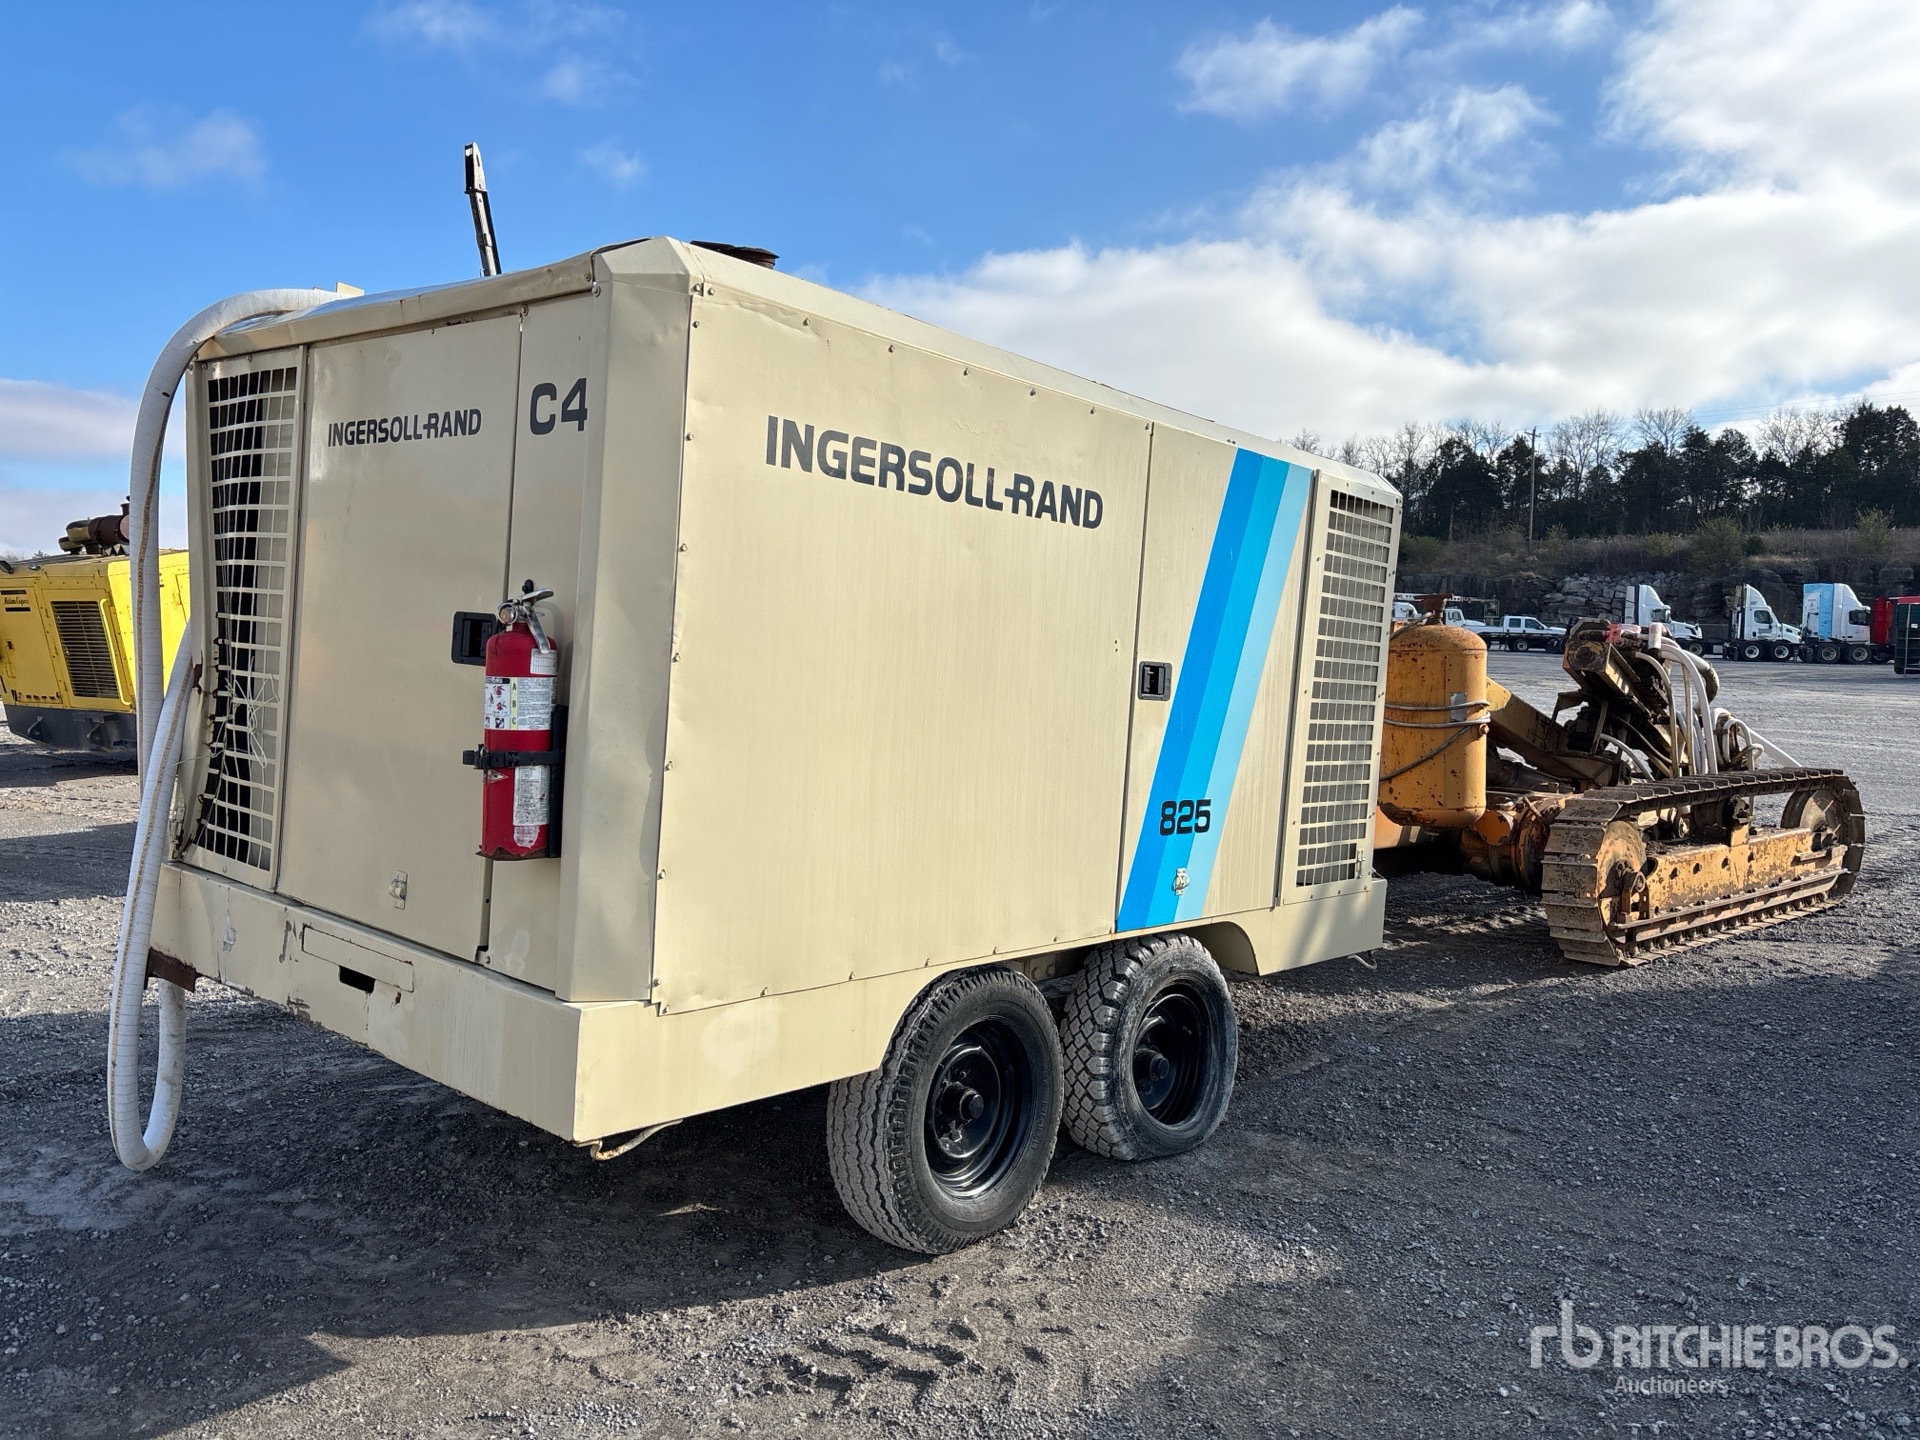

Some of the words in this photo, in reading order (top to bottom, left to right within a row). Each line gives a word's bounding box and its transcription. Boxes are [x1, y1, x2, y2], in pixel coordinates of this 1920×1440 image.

[327, 408, 482, 447] INGERSOLL-RAND
[529, 377, 588, 436] C4
[765, 414, 1104, 530] INGERSOLL-RAND
[1159, 798, 1212, 837] 825
